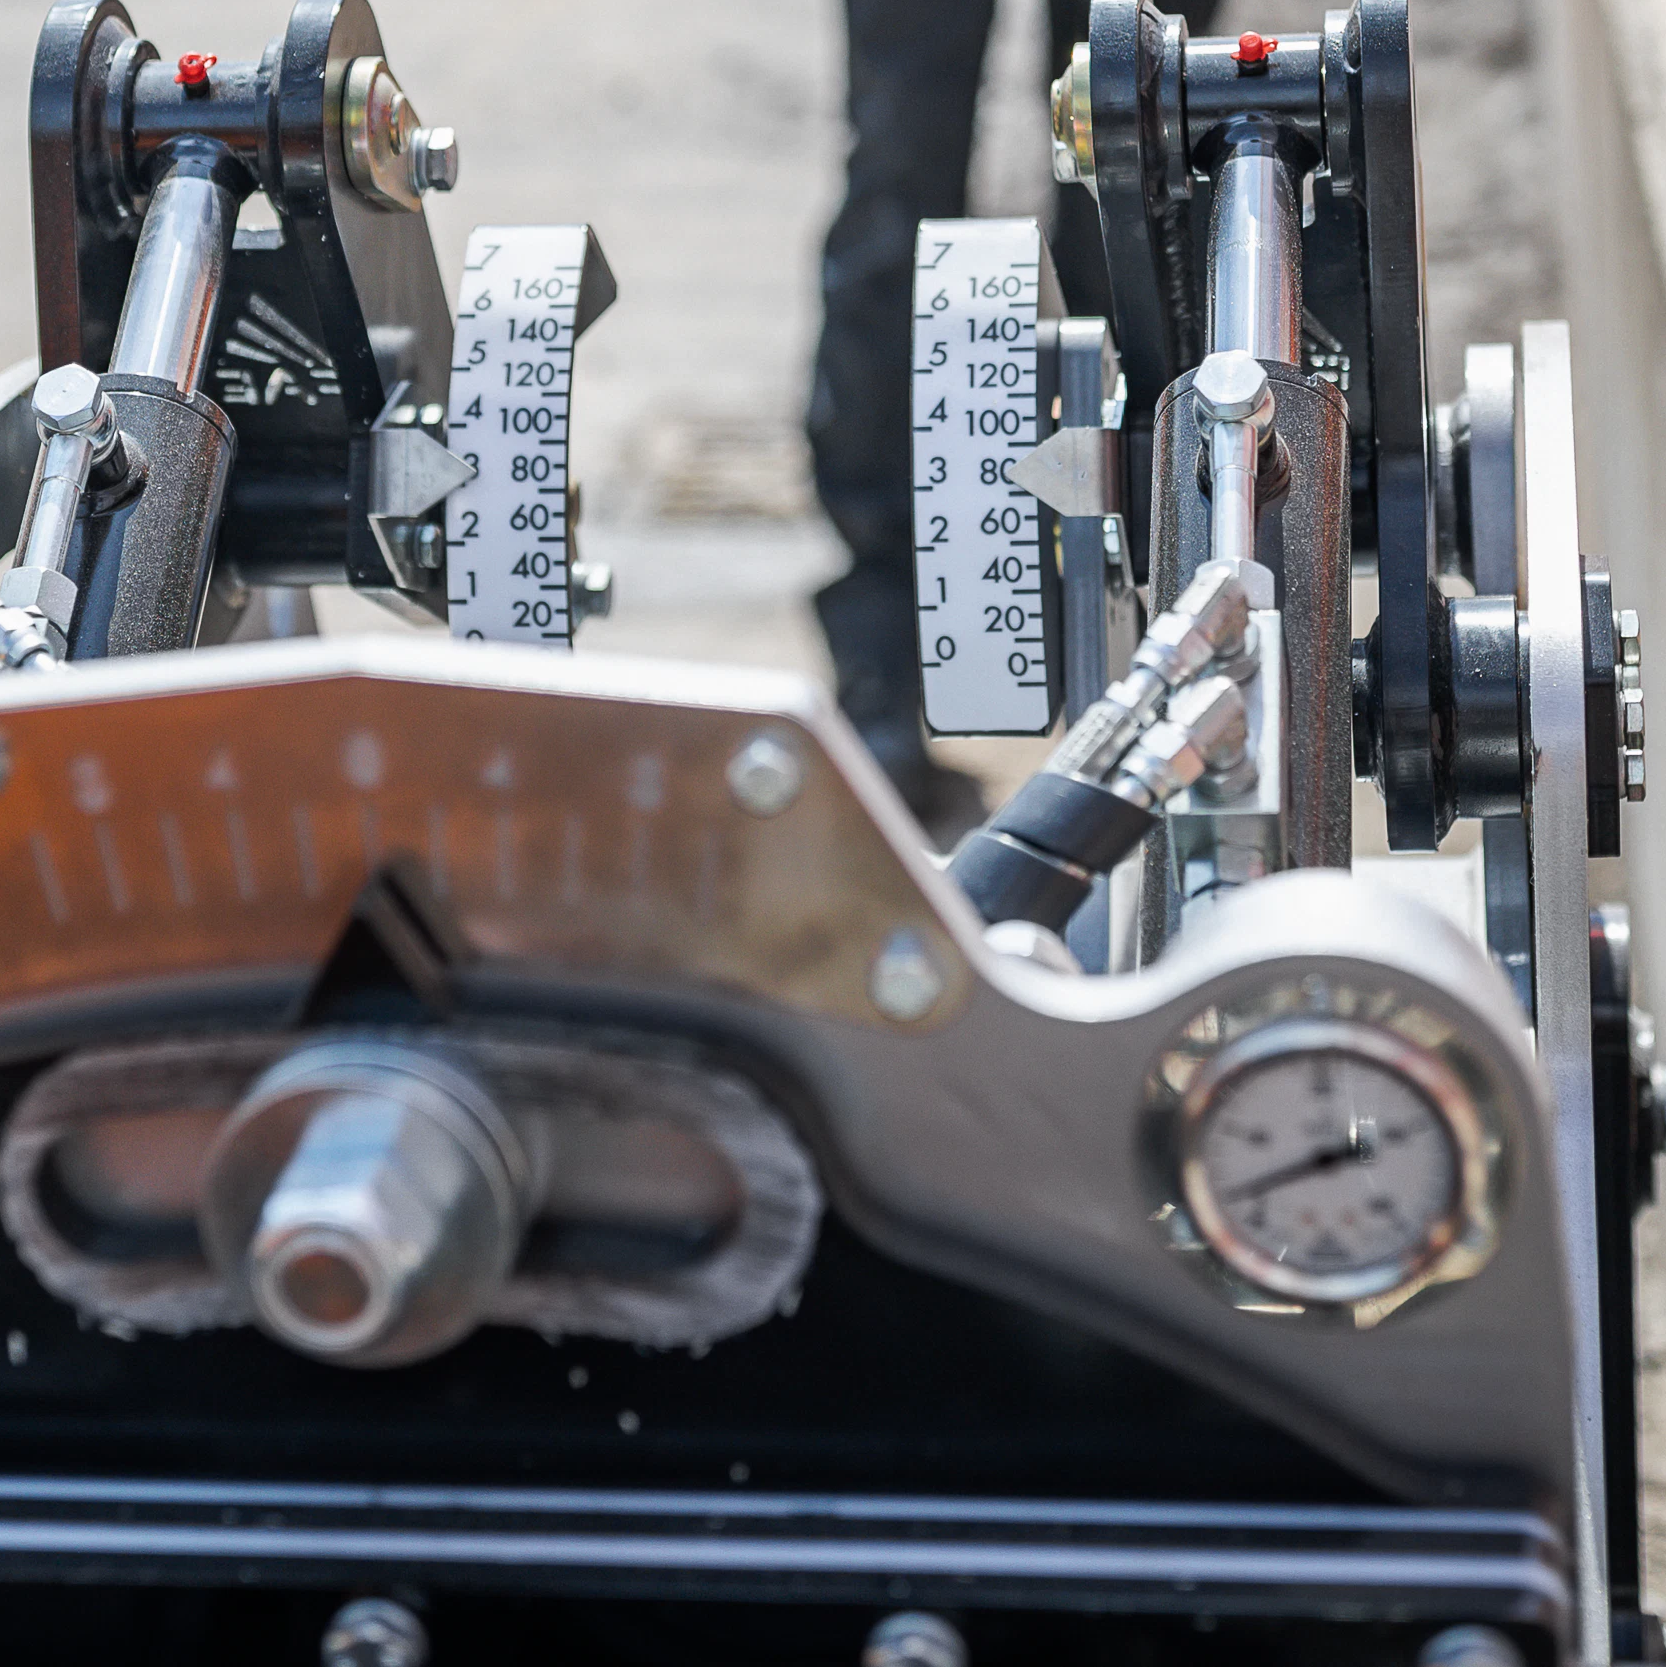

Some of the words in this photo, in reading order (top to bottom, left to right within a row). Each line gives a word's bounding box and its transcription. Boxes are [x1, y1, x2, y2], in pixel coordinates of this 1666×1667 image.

[481, 245, 501, 268] 7
[933, 242, 954, 265] 7
[474, 289, 493, 312] 6
[513, 278, 564, 300] 160
[930, 288, 950, 312] 6
[969, 276, 1022, 299] 160
[507, 318, 560, 343] 140
[966, 317, 1021, 343] 140
[468, 339, 487, 365] 5
[929, 341, 948, 368] 5
[503, 361, 555, 387] 120
[966, 362, 1020, 388] 120
[462, 393, 483, 420] 4
[928, 396, 949, 424] 4
[499, 407, 551, 435] 100
[965, 409, 1021, 436] 100
[511, 454, 551, 483] 80
[929, 455, 948, 485] 3
[980, 457, 1017, 485] 80
[461, 510, 480, 539] 2
[510, 504, 550, 532] 60
[930, 515, 950, 544] 2
[980, 506, 1022, 536] 60
[510, 551, 551, 580] 40
[981, 555, 1023, 584] 40
[466, 571, 476, 598] 1
[937, 576, 947, 604] 1
[512, 600, 552, 628] 20
[984, 605, 1026, 633] 20
[935, 635, 957, 662] 0
[1007, 651, 1029, 678] 0
